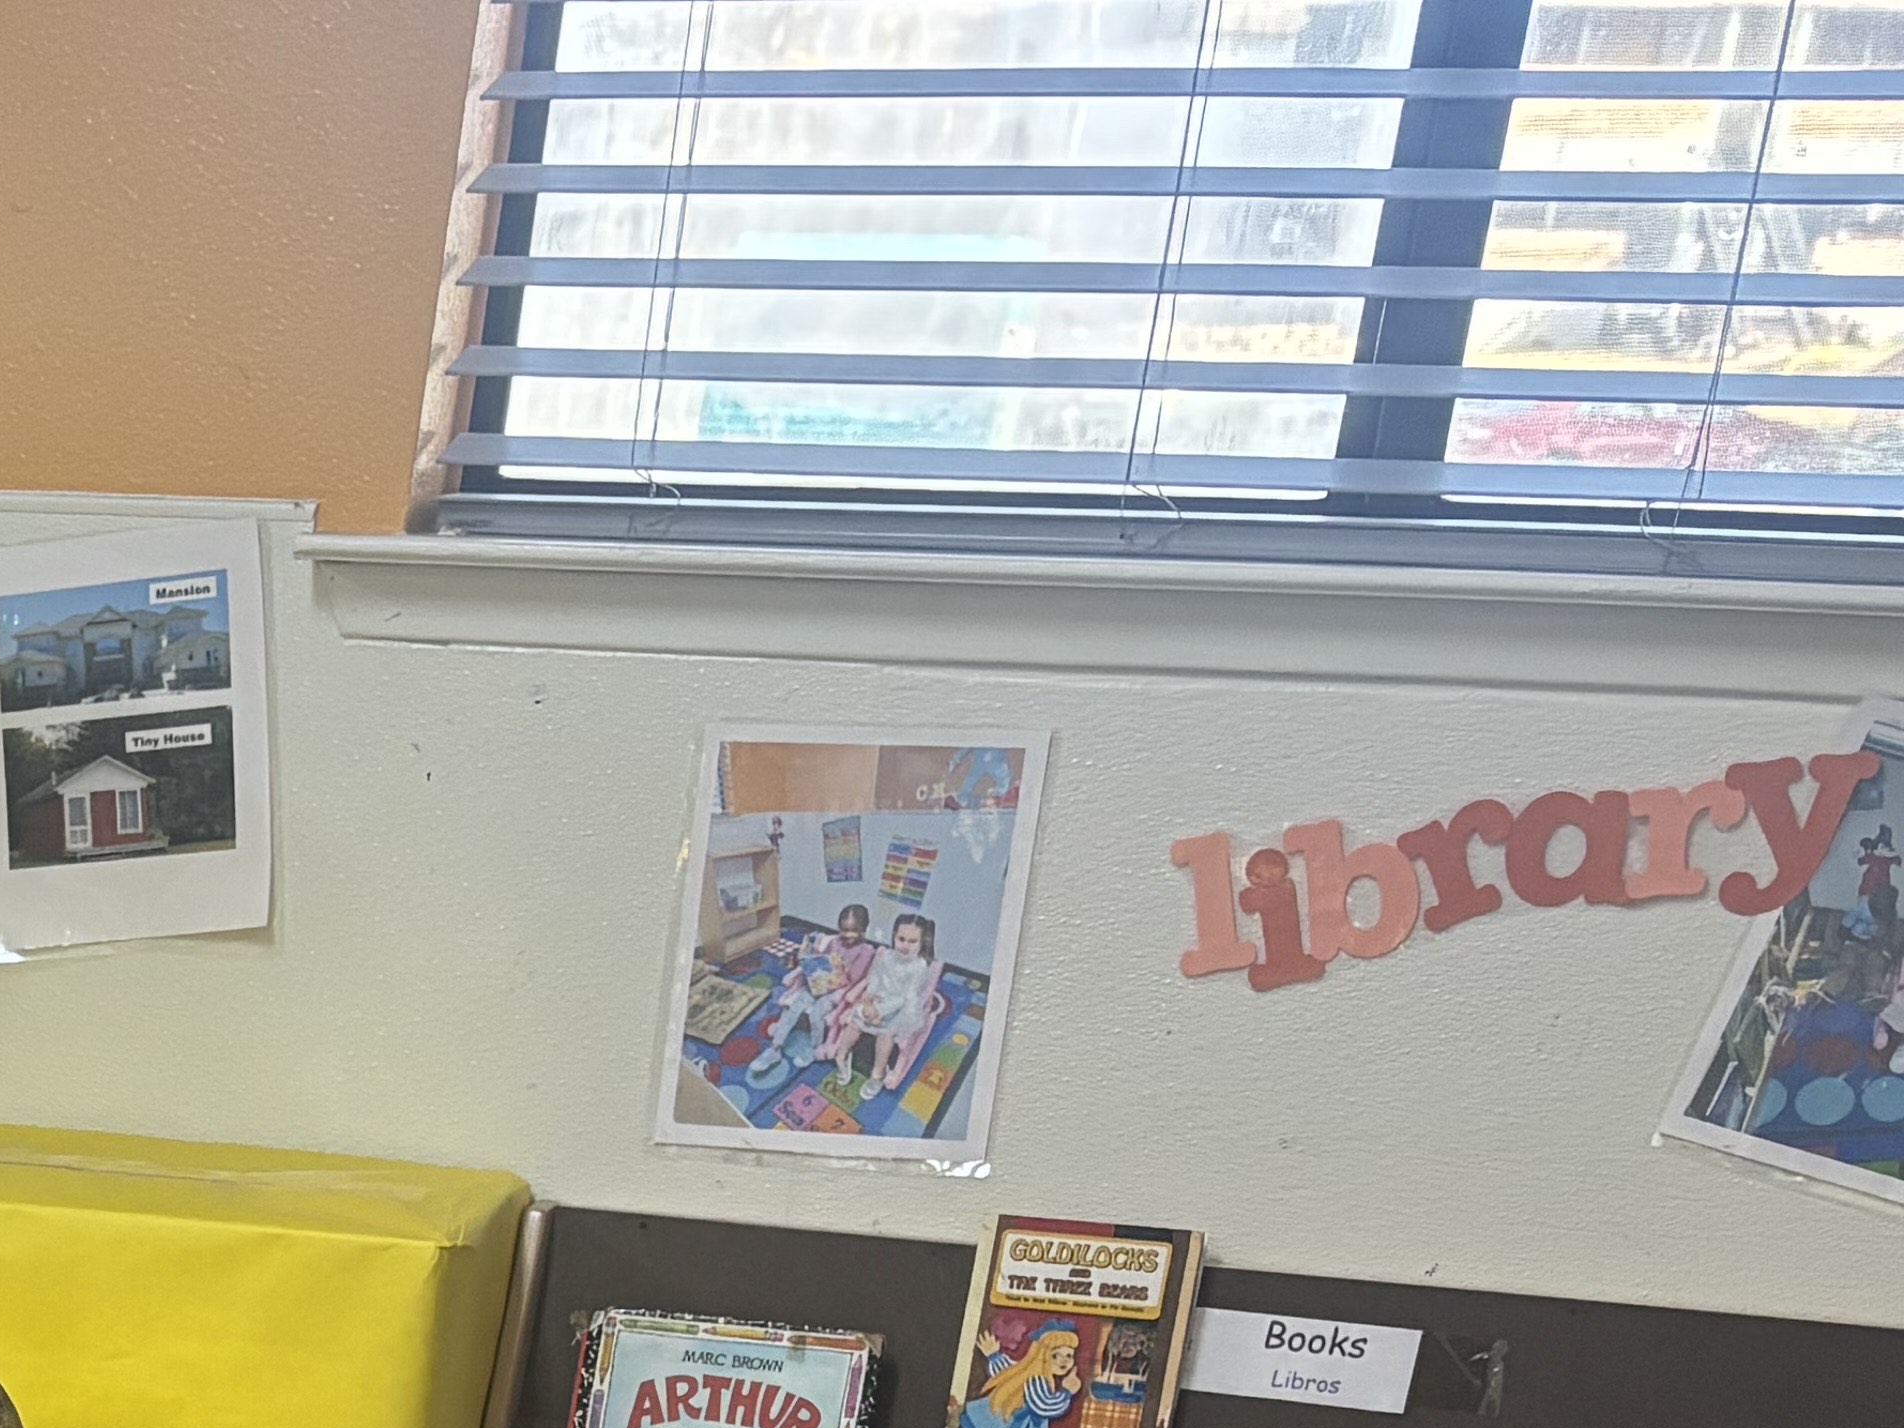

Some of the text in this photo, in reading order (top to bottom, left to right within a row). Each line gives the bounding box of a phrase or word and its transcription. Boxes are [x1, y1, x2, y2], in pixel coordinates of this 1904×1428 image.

[155, 584, 212, 600] Mansion
[132, 732, 206, 748] Tiny House
[1171, 751, 1881, 993] library
[1009, 1238, 1160, 1274] GOLDILOCKS
[1264, 1320, 1368, 1359] Books
[681, 1350, 784, 1373] MARC BROWN
[1271, 1369, 1342, 1394] Libros
